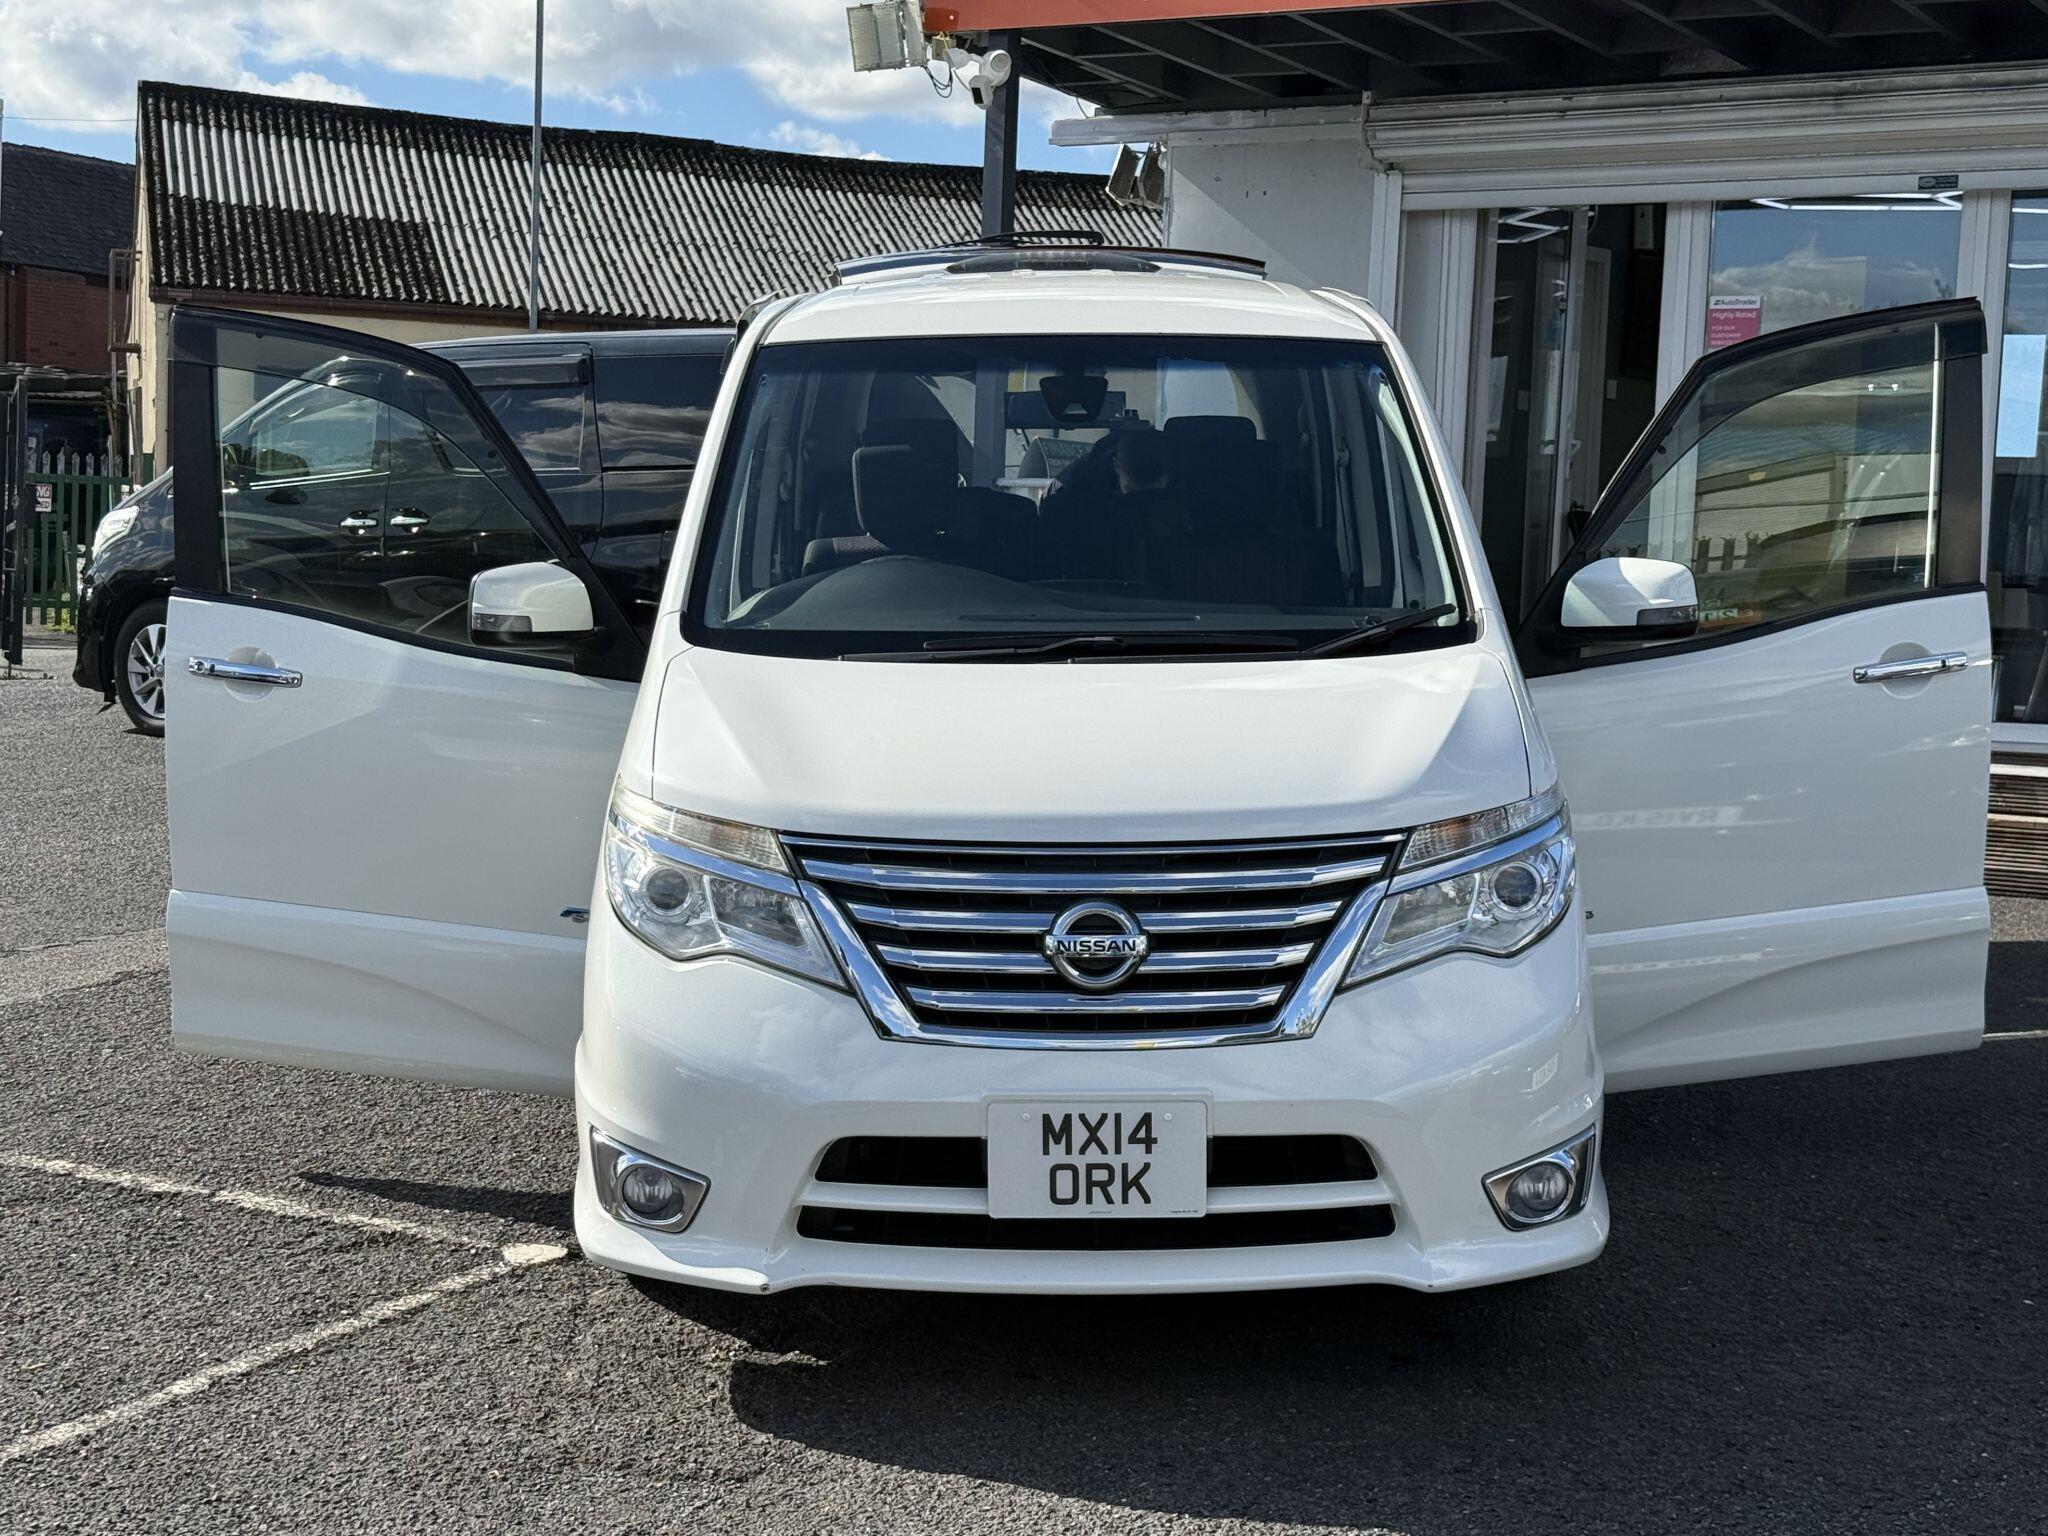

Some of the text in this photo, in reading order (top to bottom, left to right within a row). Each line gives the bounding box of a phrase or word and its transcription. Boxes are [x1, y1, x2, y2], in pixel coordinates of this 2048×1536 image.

[1712, 311, 1757, 320] Highly Rated
[1057, 939, 1136, 953] NISSAN
[1042, 1112, 1158, 1156] MX14
[1049, 1162, 1152, 1206] ORK
